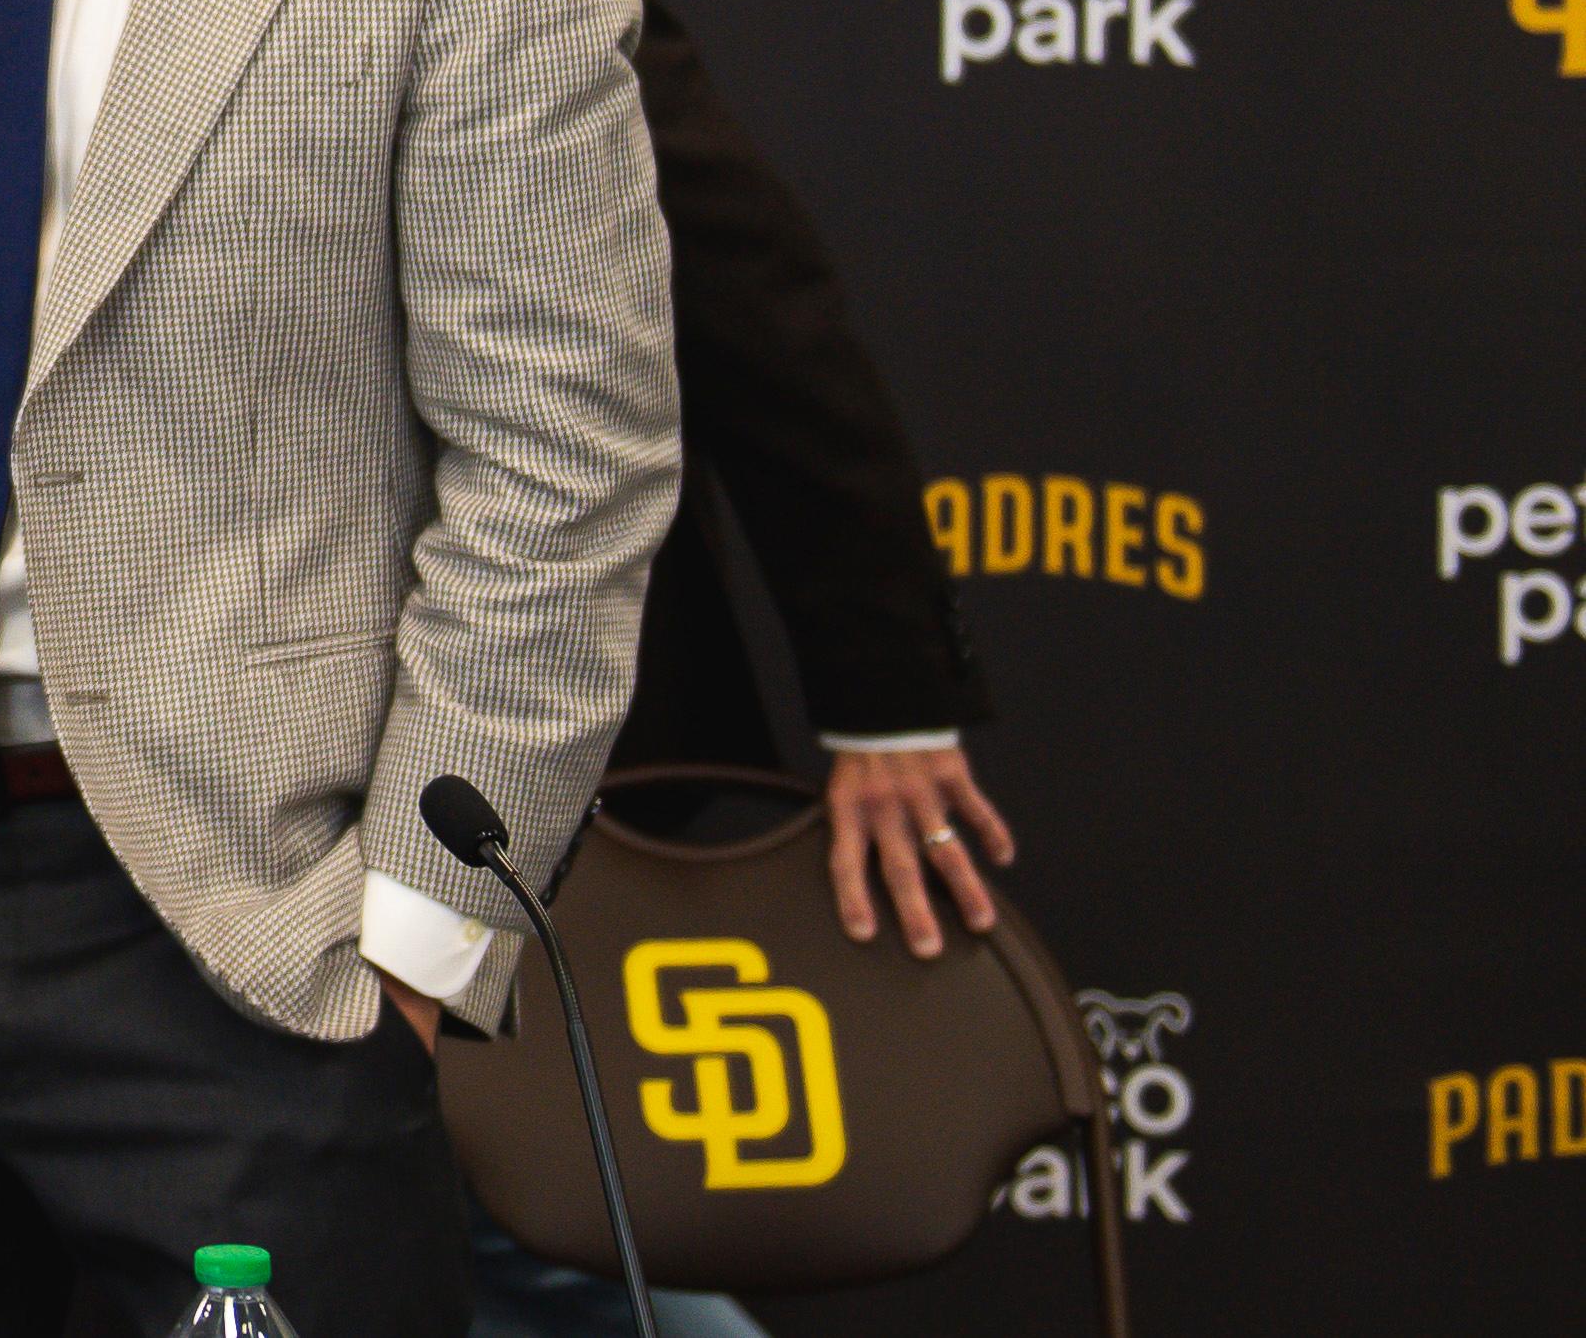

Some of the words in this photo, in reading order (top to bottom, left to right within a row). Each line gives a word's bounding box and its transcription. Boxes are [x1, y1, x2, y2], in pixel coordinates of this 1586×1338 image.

[923, 473, 1205, 602] ADRES
[624, 938, 848, 1190] SD
[1429, 1058, 1586, 1179] PAD
